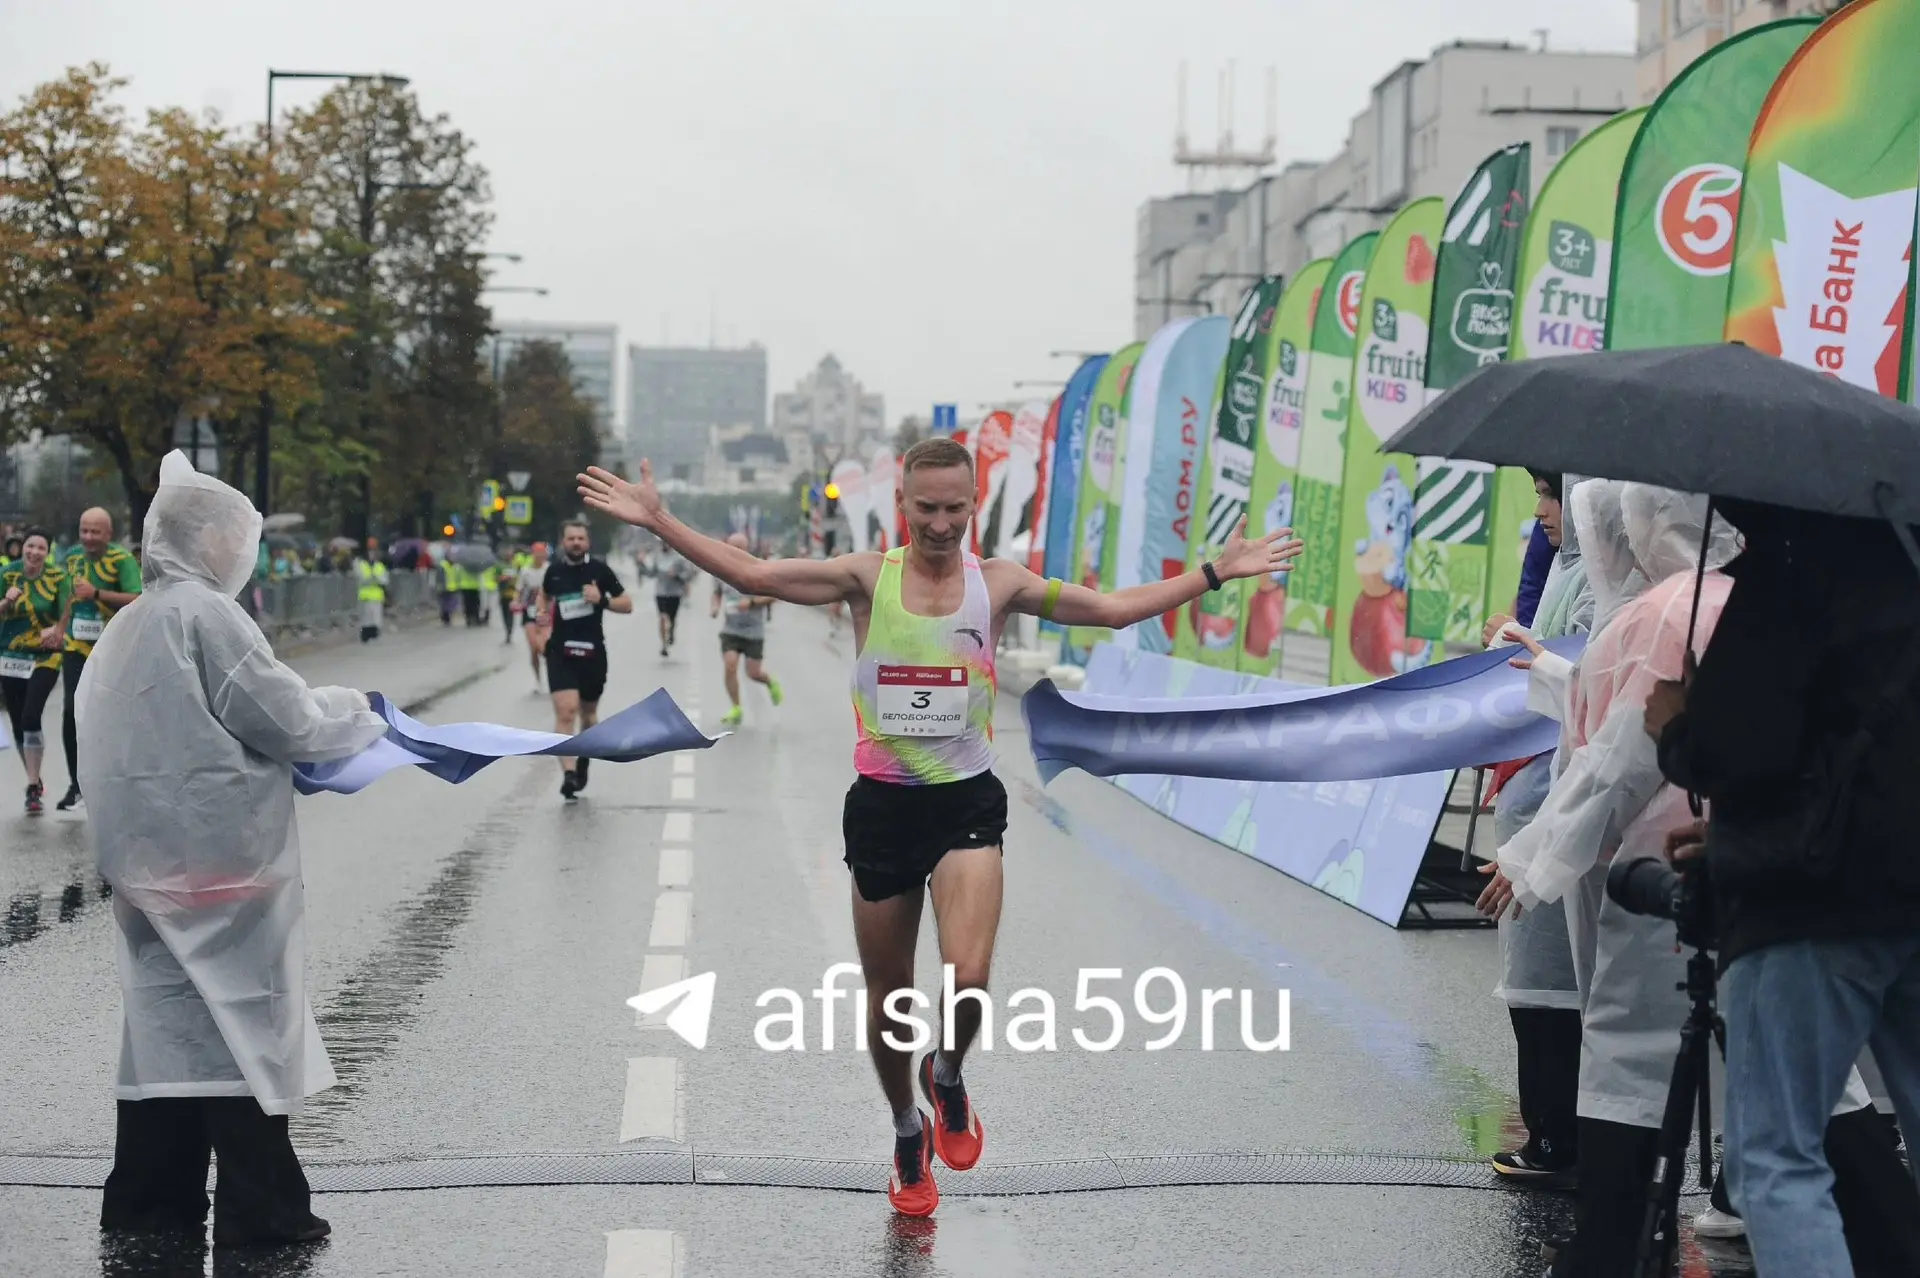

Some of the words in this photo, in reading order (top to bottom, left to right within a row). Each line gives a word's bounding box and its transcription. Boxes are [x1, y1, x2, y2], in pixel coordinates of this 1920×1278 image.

[1681, 172, 1742, 255] 5
[1554, 228, 1590, 256] 3+
[1809, 217, 1863, 334] Банк
[1539, 277, 1606, 322] fru
[1538, 320, 1605, 350] KIDS
[1366, 343, 1425, 382] fruit
[1273, 376, 1304, 407] fru
[1367, 379, 1408, 403] KIDS
[910, 691, 932, 709] 3
[882, 712, 961, 723] БЕЛОБОРОДОВ
[1110, 683, 1542, 754] МАРАФО
